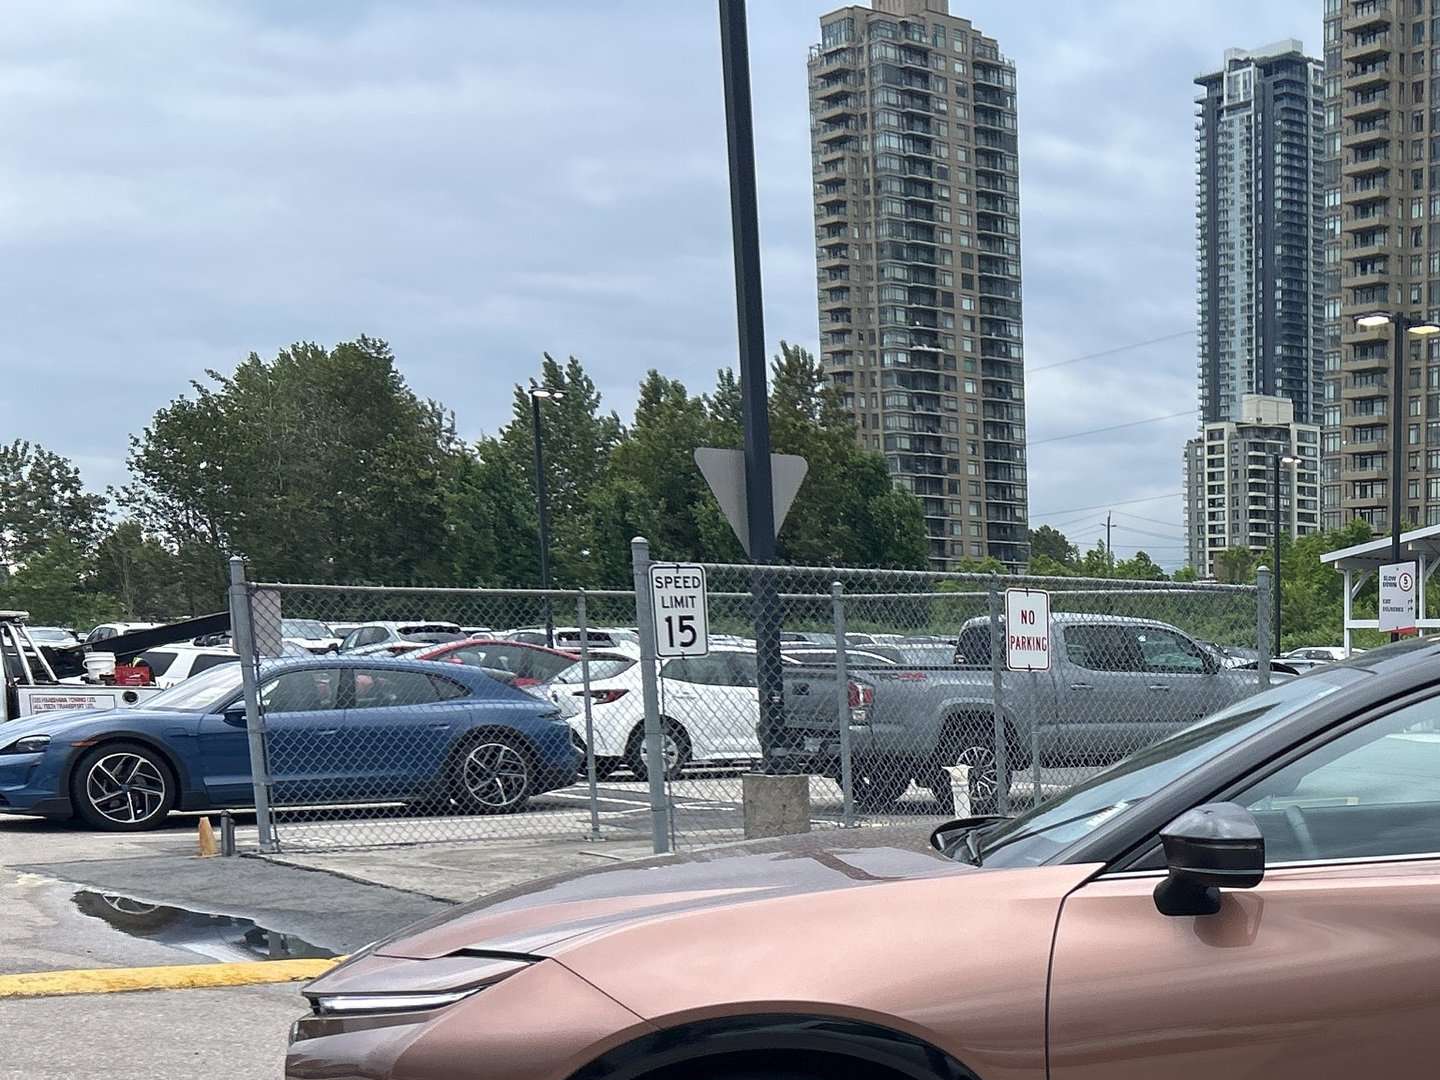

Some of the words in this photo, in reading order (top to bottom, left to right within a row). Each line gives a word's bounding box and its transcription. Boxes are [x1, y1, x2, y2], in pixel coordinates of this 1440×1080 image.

[655, 576, 701, 589] SPEED
[1403, 576, 1408, 585] 5
[661, 596, 697, 608] LIMIT
[1021, 610, 1035, 625] NO
[664, 615, 697, 648] 15
[1010, 635, 1047, 651] PARKING
